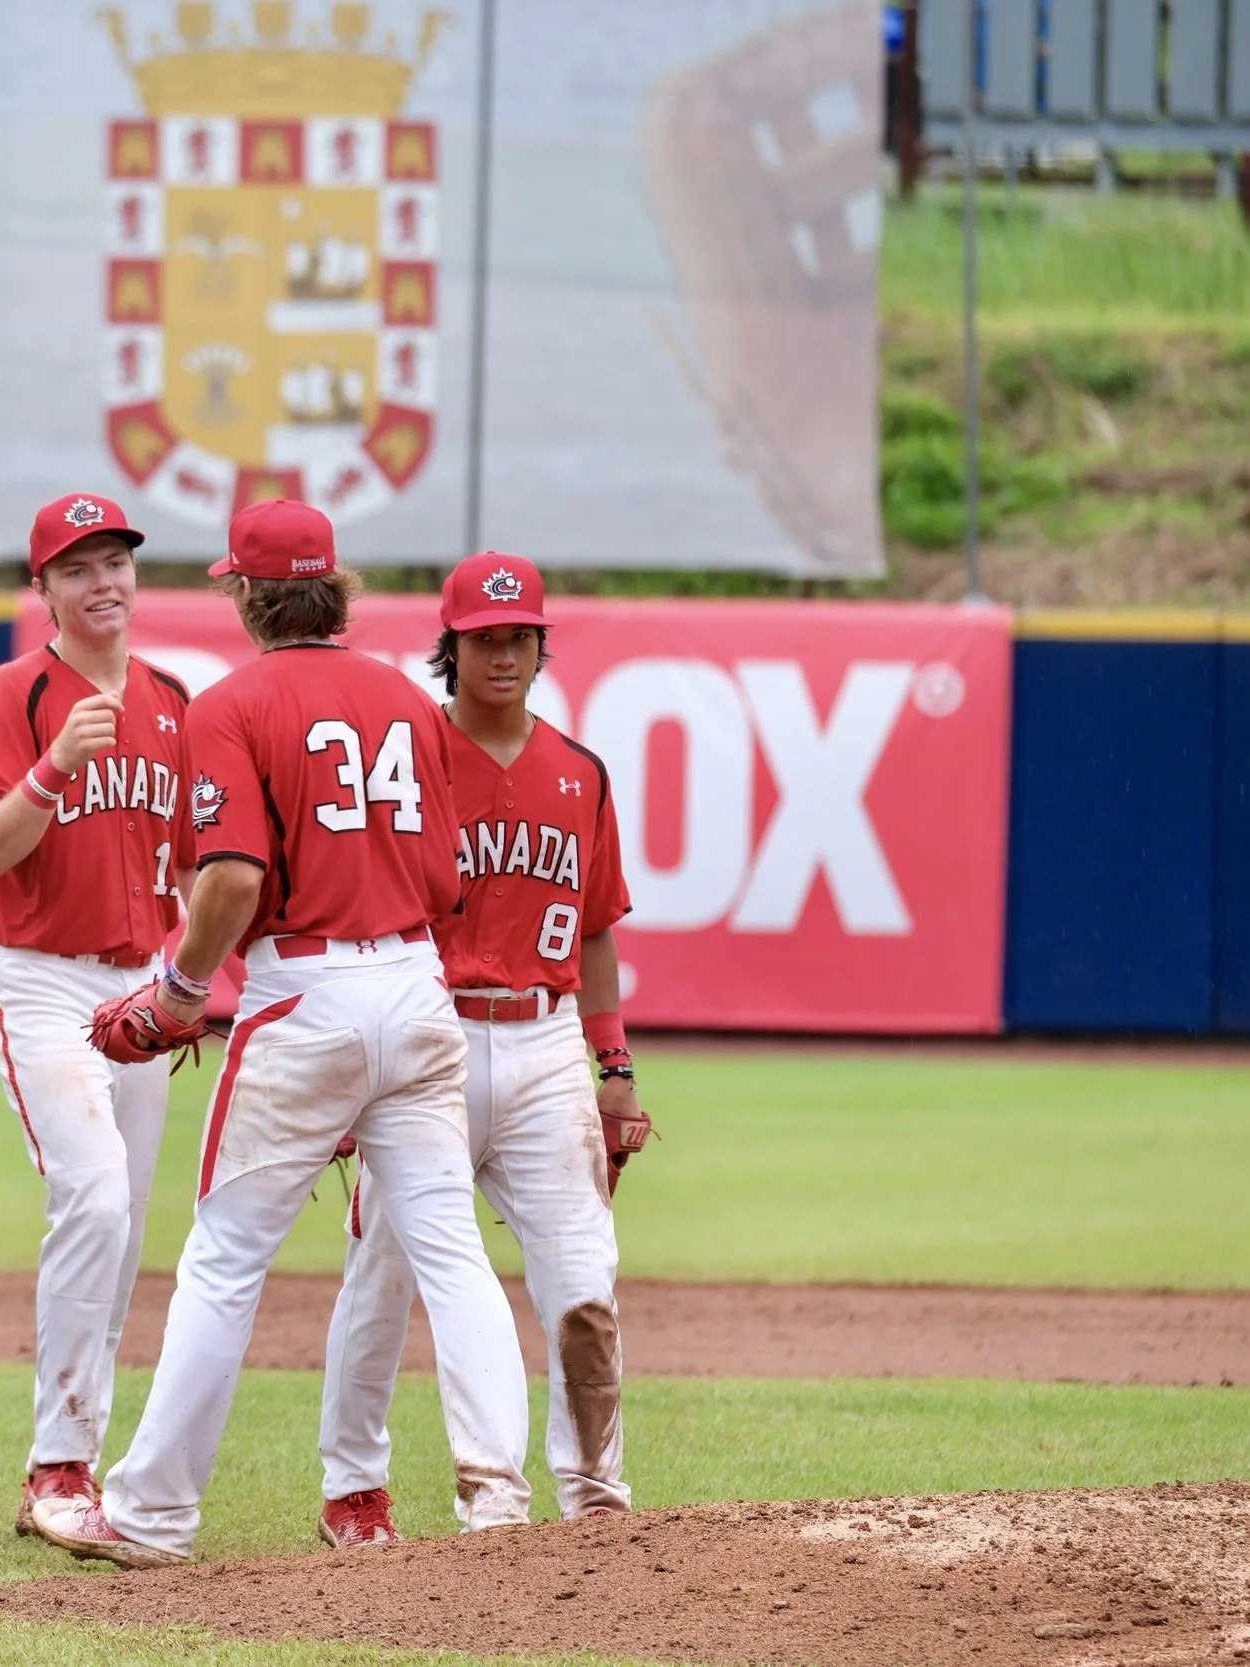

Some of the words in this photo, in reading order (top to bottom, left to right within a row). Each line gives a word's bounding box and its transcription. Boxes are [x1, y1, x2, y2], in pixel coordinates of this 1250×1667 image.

[305, 719, 422, 834] 34
[153, 841, 178, 896] 1
[456, 820, 580, 893] ANADA
[536, 902, 579, 962] 8
